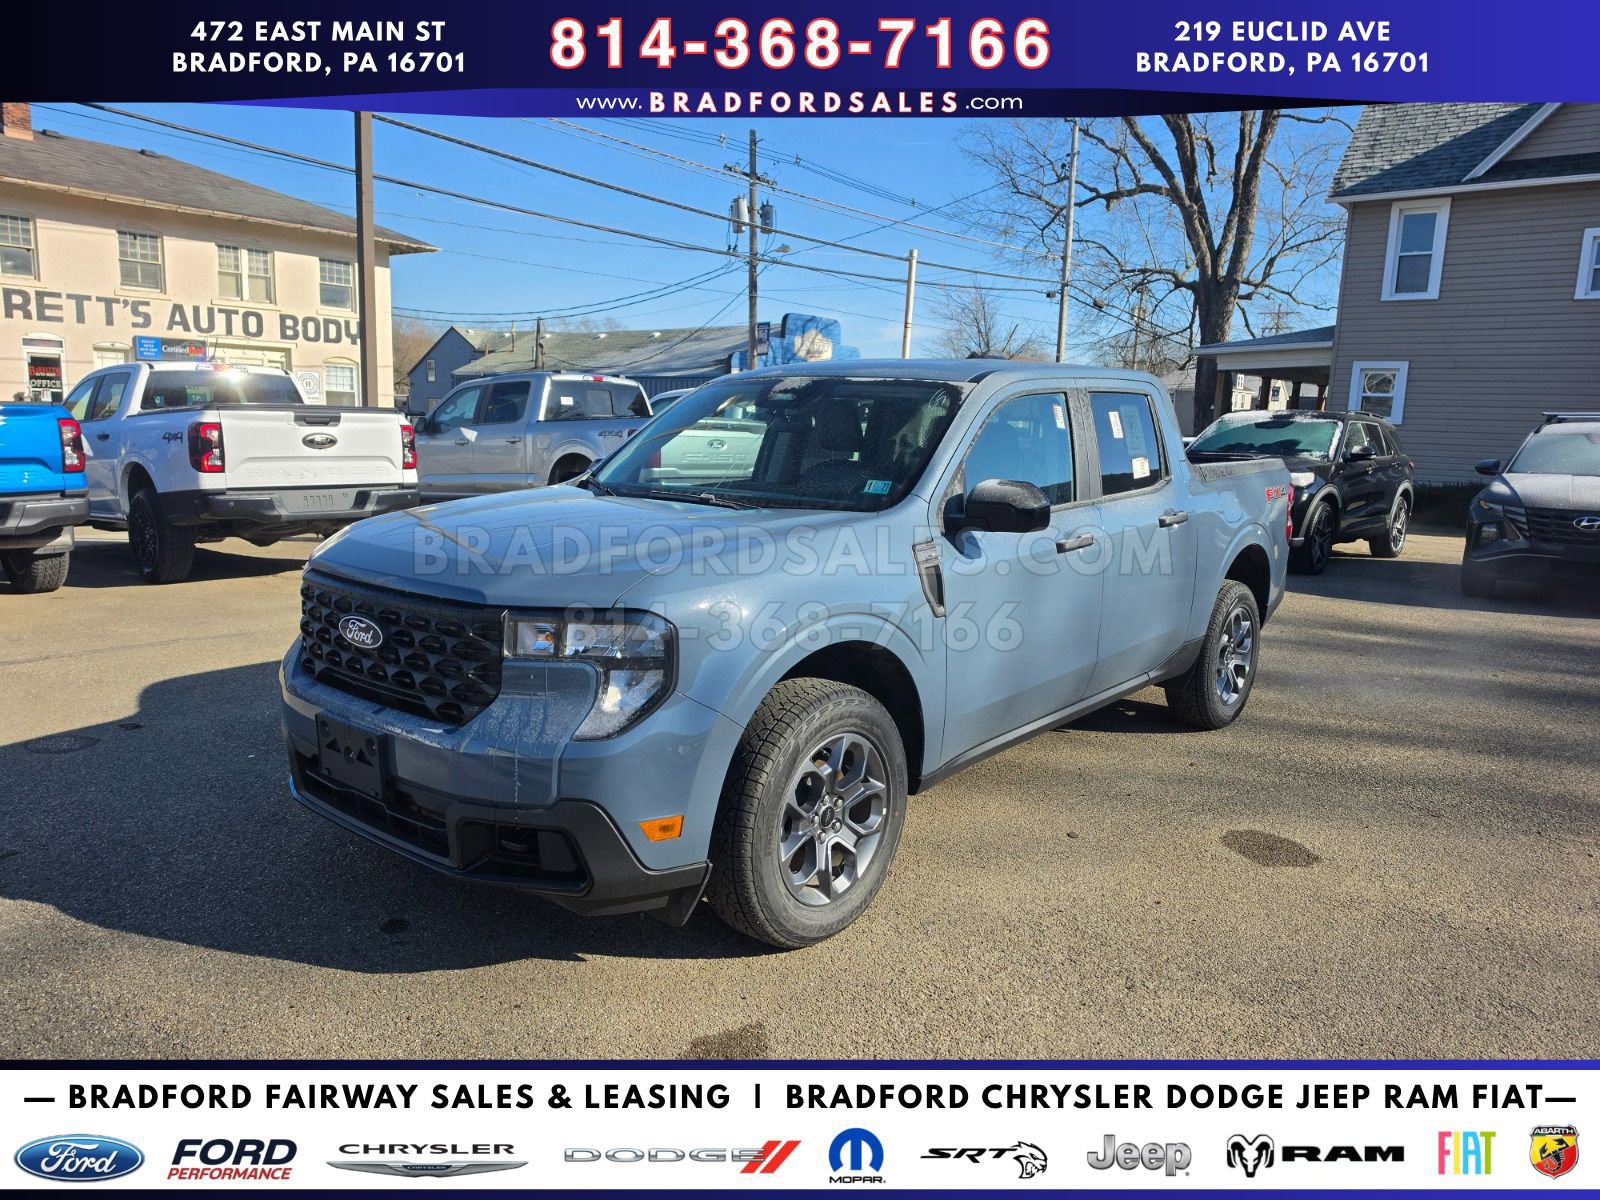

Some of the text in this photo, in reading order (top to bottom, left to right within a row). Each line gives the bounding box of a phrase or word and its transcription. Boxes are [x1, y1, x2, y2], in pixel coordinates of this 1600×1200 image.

[166, 303, 264, 338] AUTO
[279, 313, 361, 346] BODY
[30, 379, 62, 388] OFFICE
[346, 619, 374, 645] Ford
